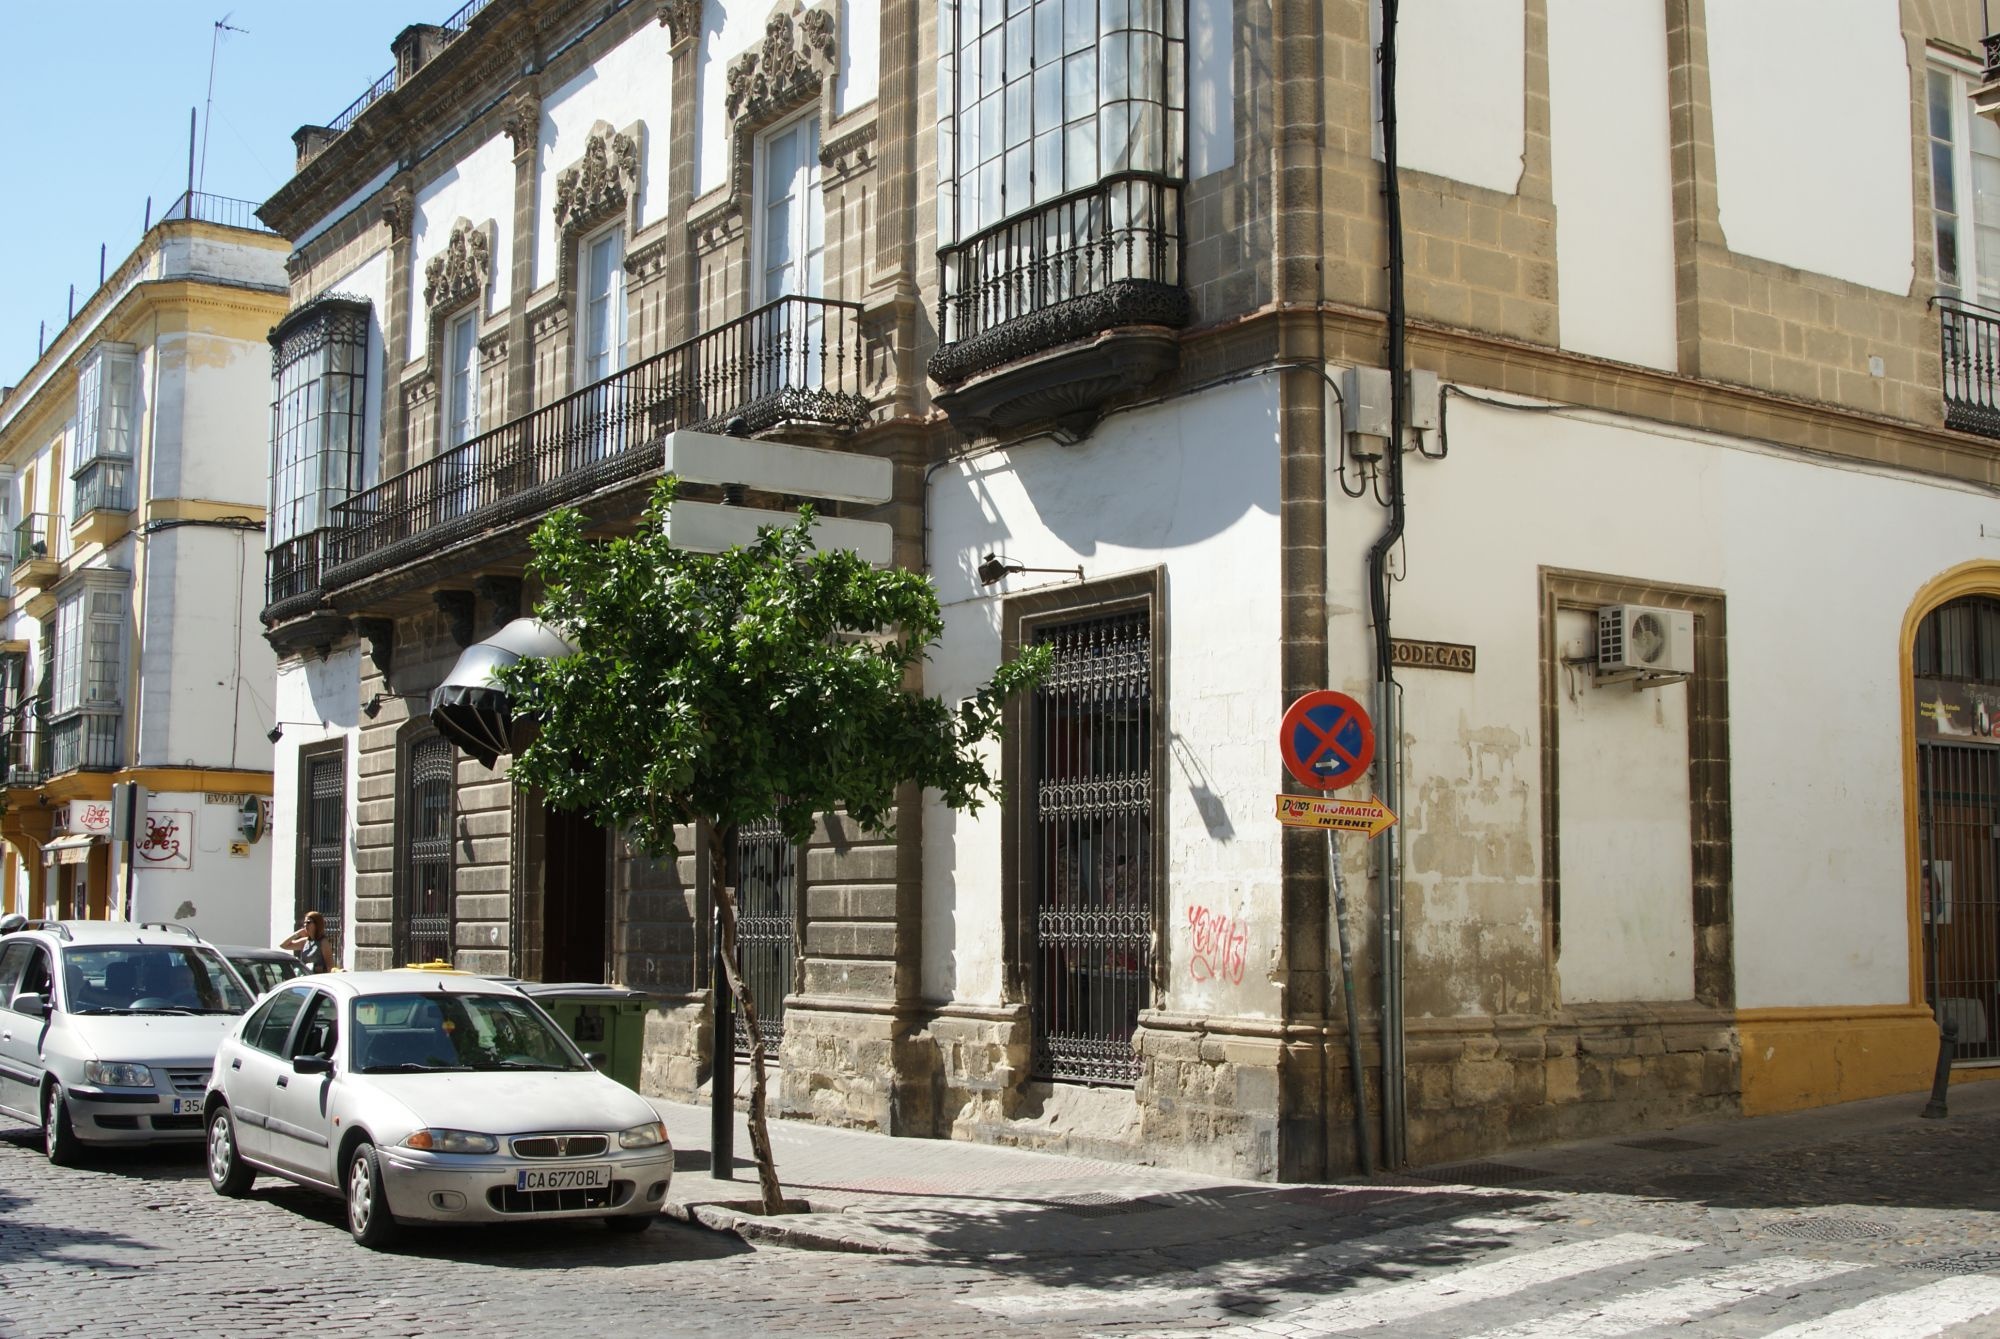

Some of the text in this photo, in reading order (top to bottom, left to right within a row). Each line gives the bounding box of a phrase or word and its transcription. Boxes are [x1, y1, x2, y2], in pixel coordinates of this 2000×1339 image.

[1391, 644, 1471, 667] BODEGAS
[87, 804, 110, 818] Bar
[1313, 803, 1384, 818] INORMATICA
[80, 815, 110, 828] Jerez
[146, 817, 180, 838] Bar
[1318, 817, 1374, 829] INTERNET
